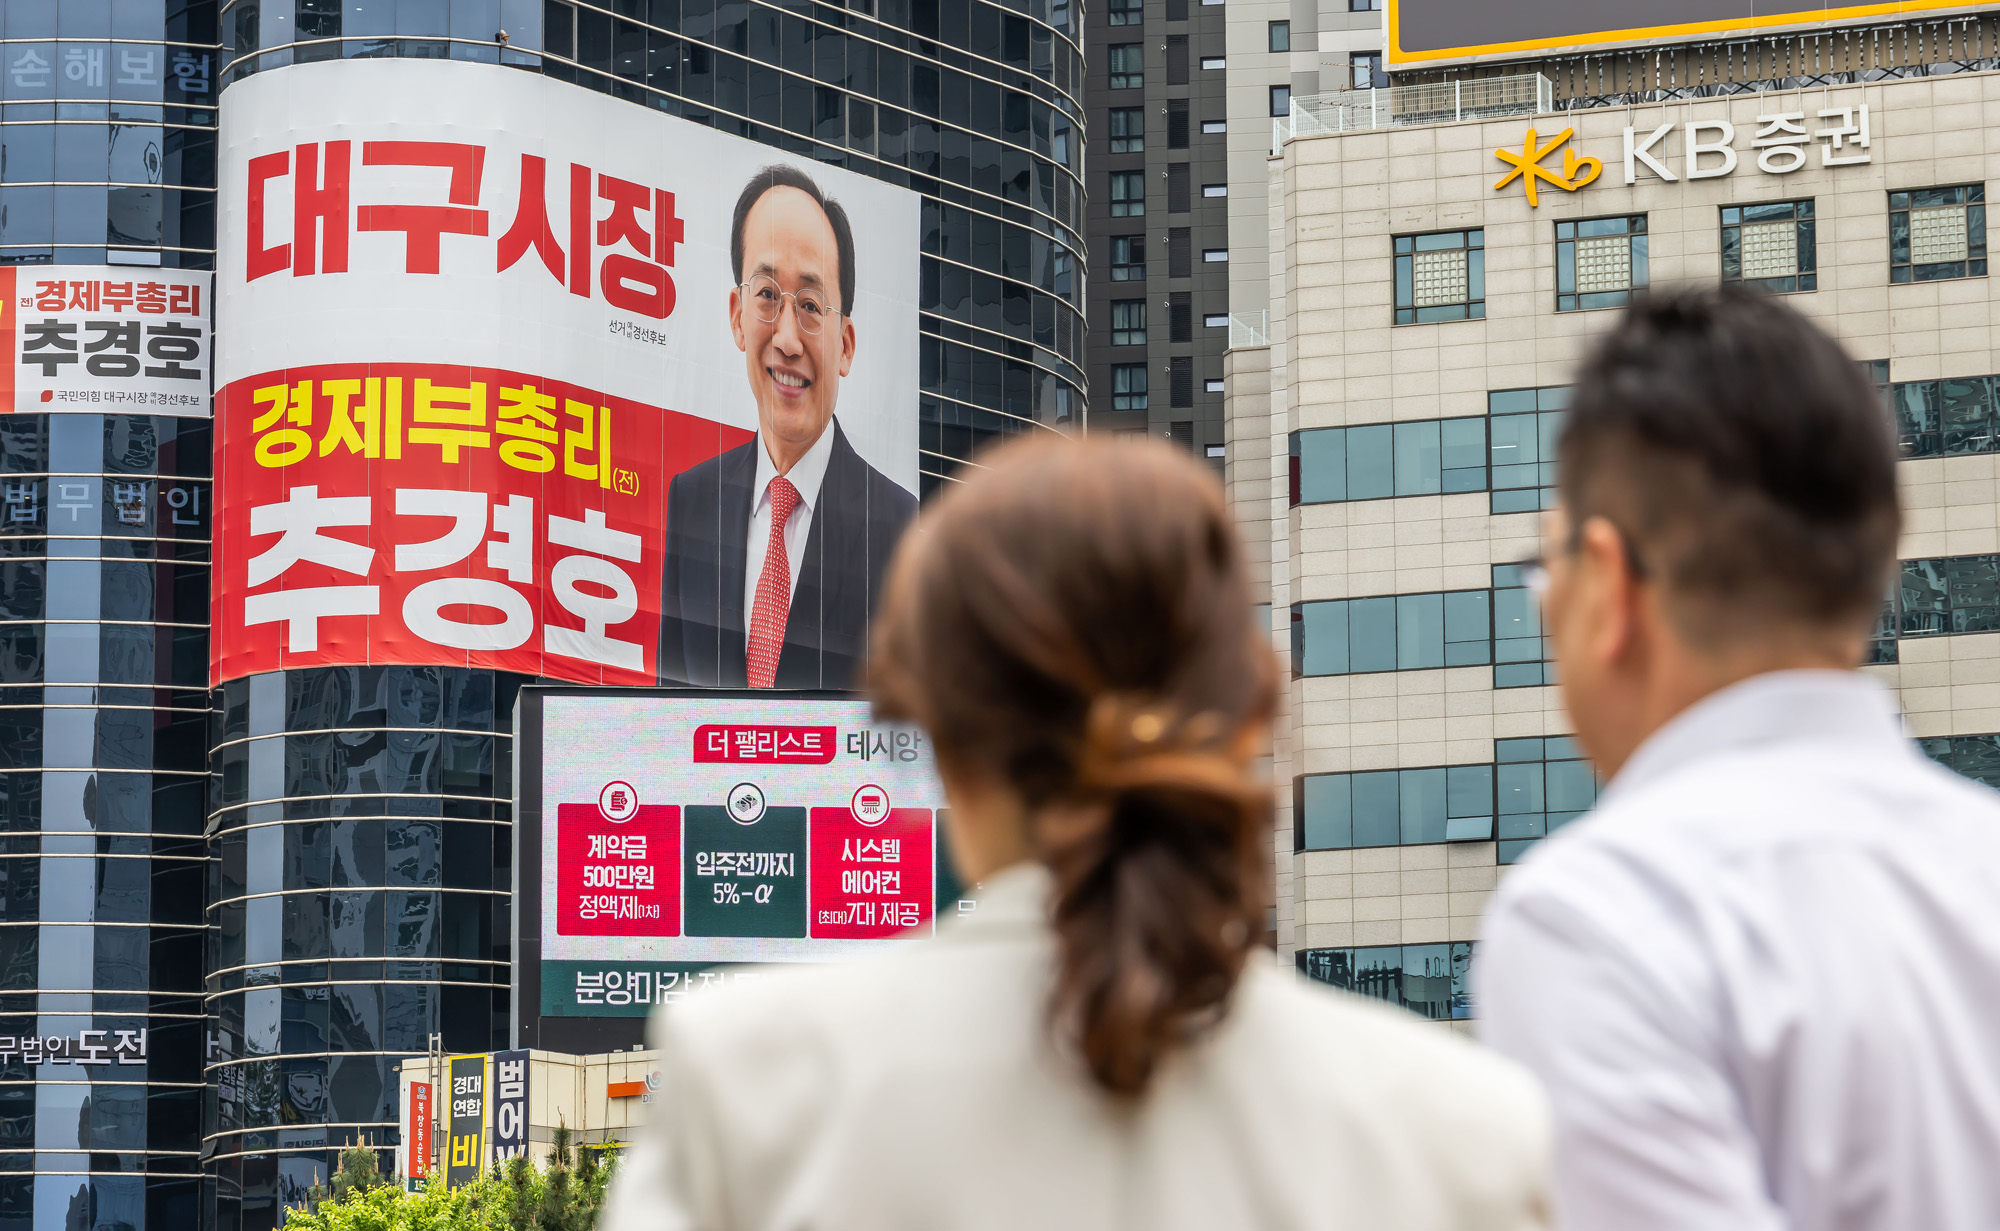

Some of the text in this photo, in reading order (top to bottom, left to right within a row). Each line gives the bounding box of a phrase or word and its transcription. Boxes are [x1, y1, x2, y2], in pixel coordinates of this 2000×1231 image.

[11, 49, 209, 92] 손해보험
[246, 140, 685, 320] 대구시장
[22, 319, 202, 380] 추경호
[57, 390, 101, 404] 국민의힘
[104, 390, 148, 404] 대구시장
[6, 482, 200, 526] 법무법인
[245, 485, 645, 673] 추경호
[707, 730, 922, 762] 더 팰리스트 데시앙
[587, 835, 648, 860] 계약금
[841, 839, 901, 863] 시스템
[695, 852, 795, 877] 입주전까지
[583, 865, 655, 890] 500만원
[841, 870, 901, 895] 에어컨
[880, 902, 920, 927] 제공
[75, 1027, 148, 1065] 도전
[453, 1075, 482, 1095] 경대
[453, 1098, 482, 1118] 연합
